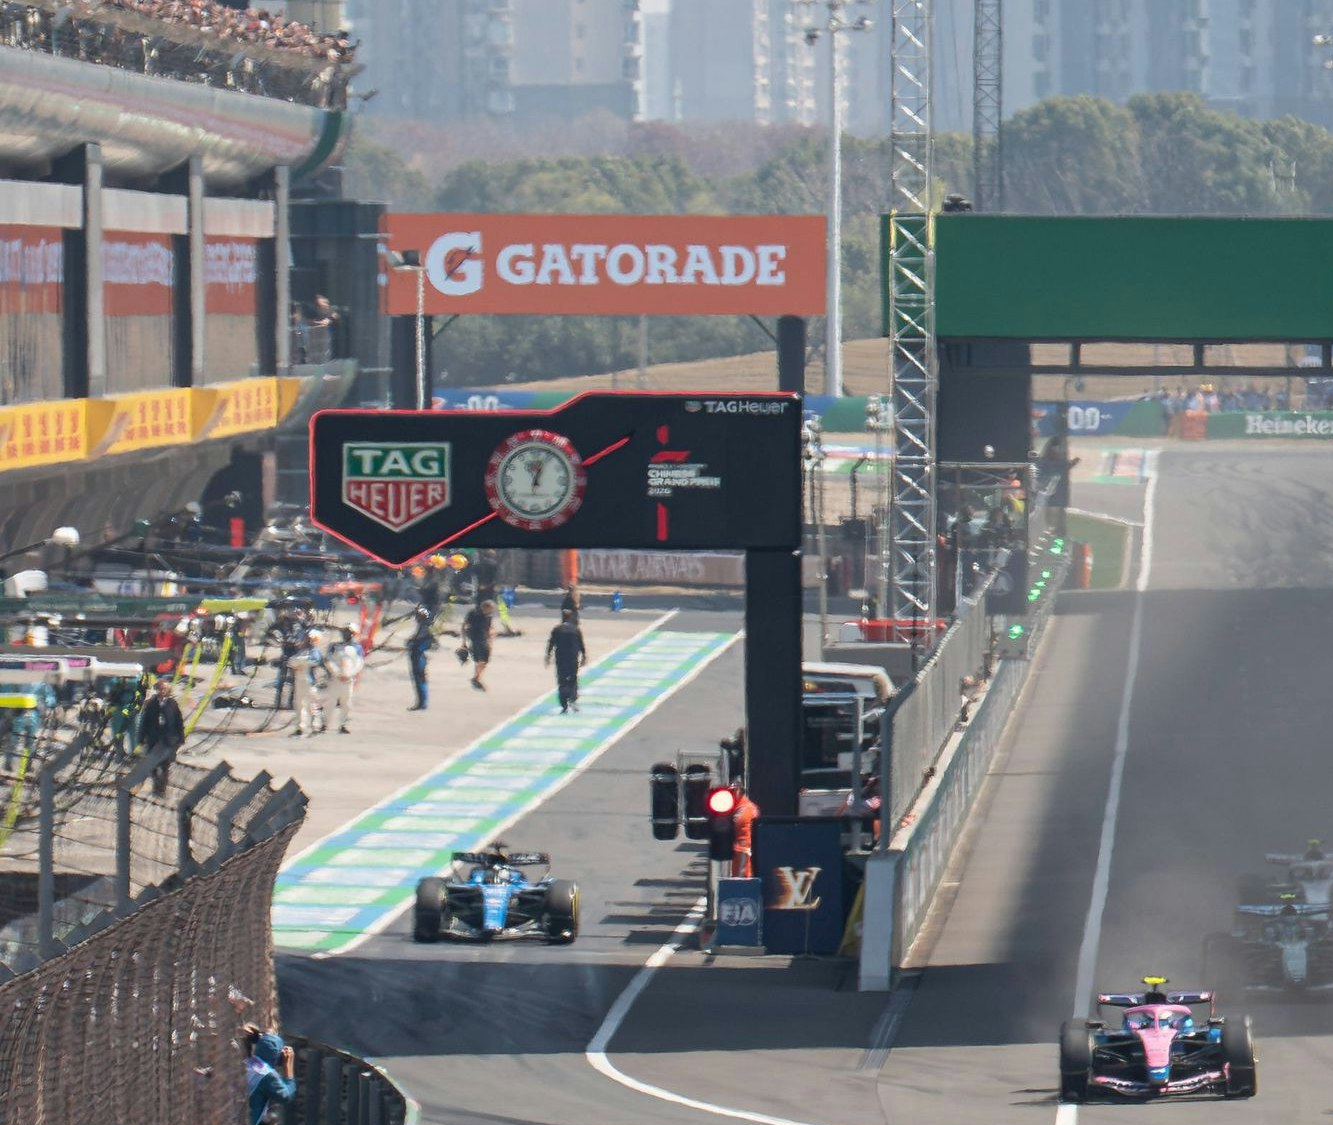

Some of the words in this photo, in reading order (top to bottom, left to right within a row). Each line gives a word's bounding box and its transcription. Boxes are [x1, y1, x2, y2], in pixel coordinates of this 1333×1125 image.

[496, 243, 787, 286] GATORADE
[352, 449, 440, 475] TAG
[350, 482, 443, 524] HEUER
